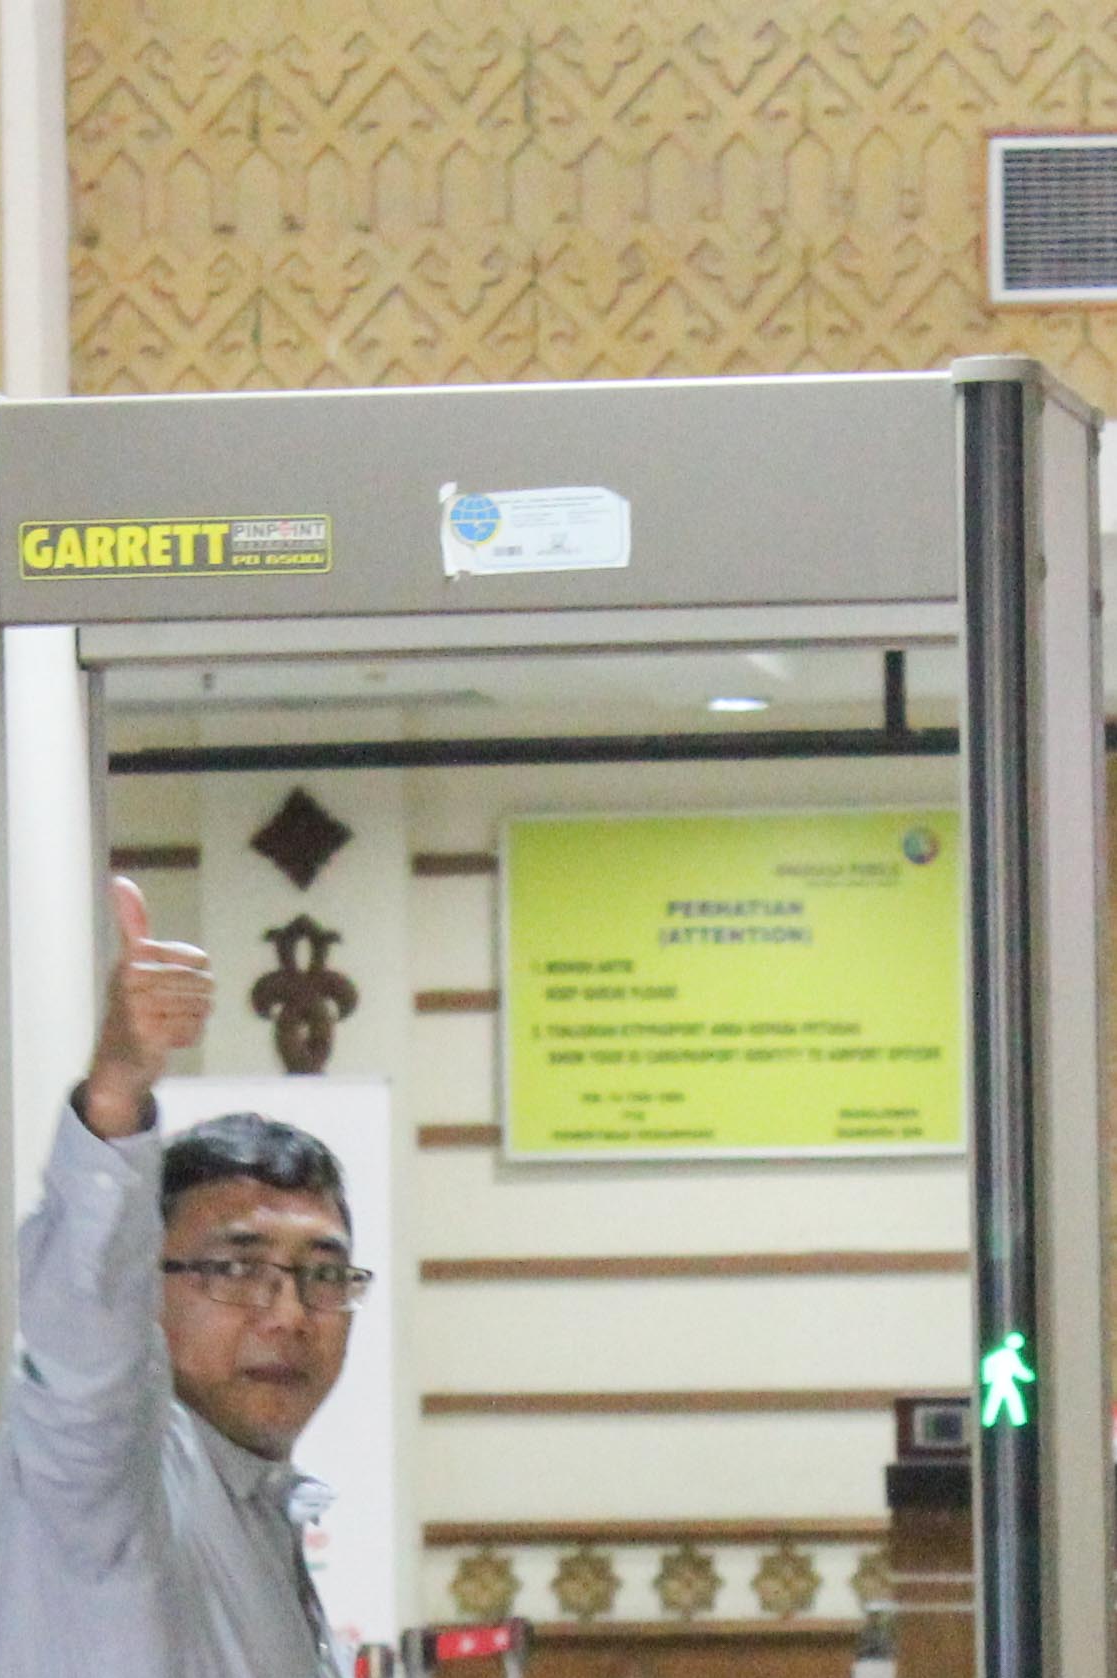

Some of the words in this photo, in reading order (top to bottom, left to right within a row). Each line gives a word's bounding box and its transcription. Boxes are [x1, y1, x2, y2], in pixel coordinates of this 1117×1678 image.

[23, 523, 230, 570] GARRETT
[232, 554, 260, 567] PD
[666, 900, 805, 917] PERHATIAN
